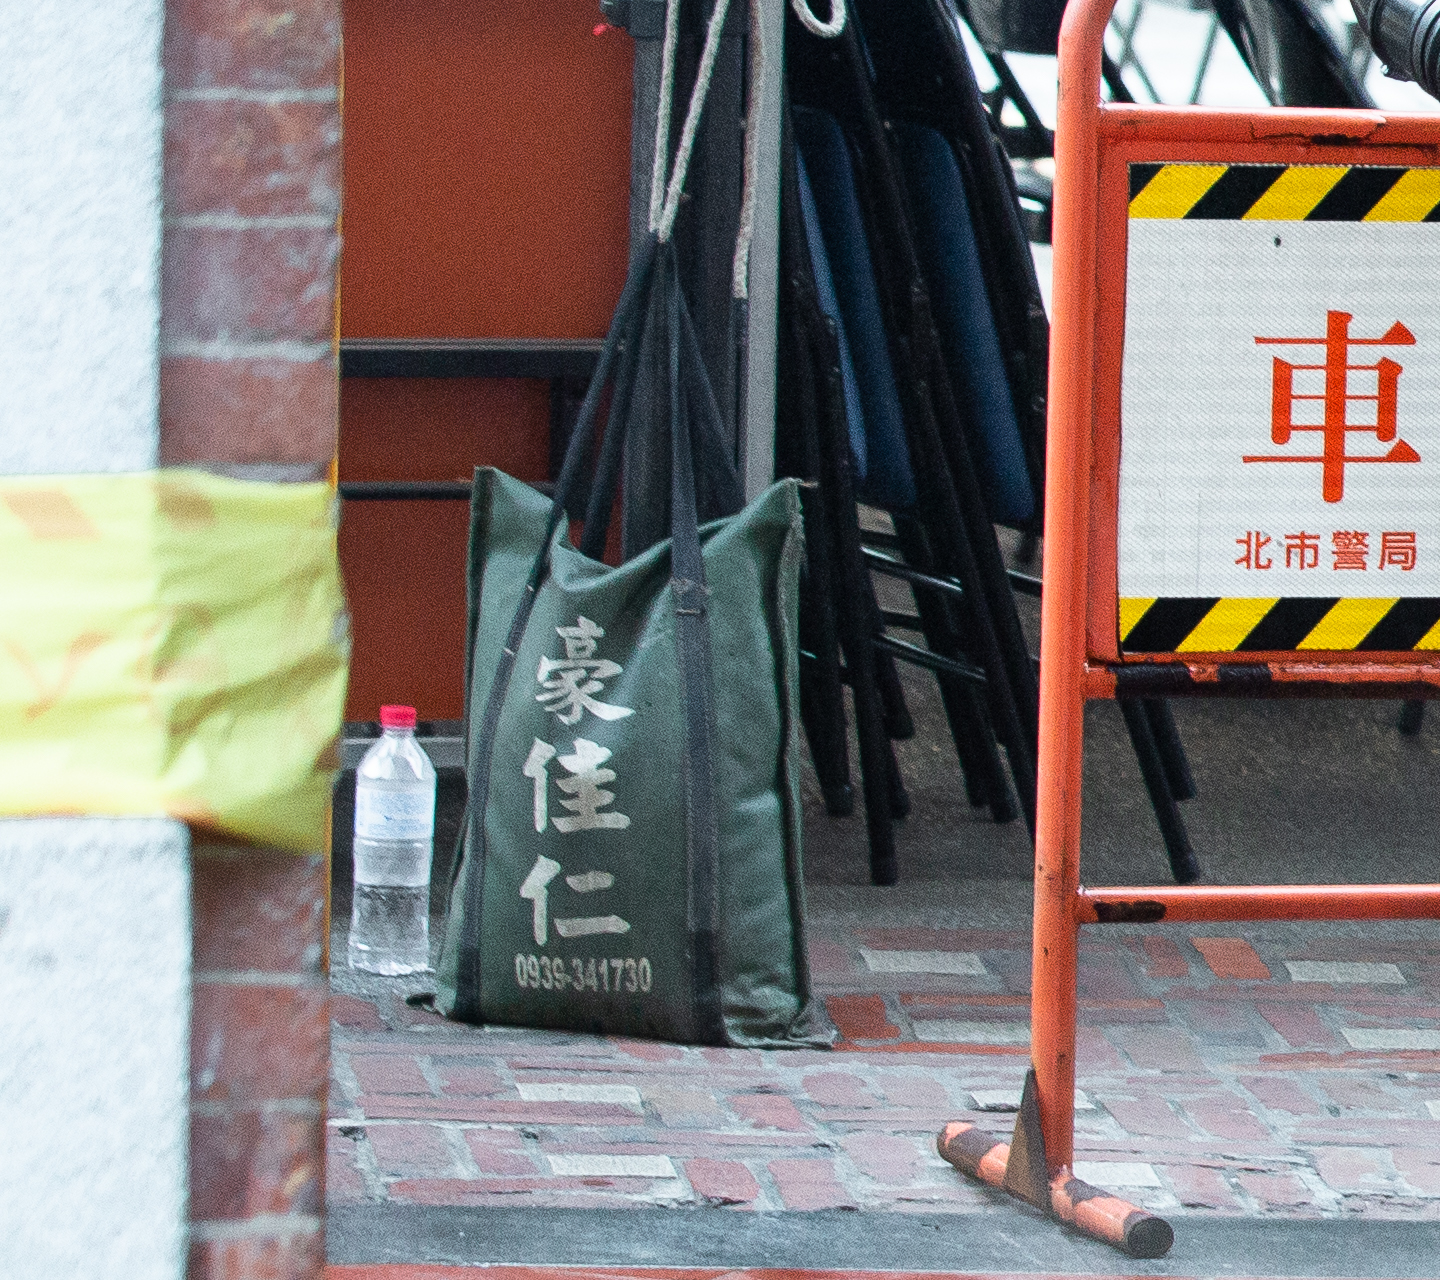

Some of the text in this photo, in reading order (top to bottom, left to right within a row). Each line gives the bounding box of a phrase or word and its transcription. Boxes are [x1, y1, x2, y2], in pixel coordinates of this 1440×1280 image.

[1242, 310, 1422, 503] 車
[1234, 530, 1418, 572] 北市警局
